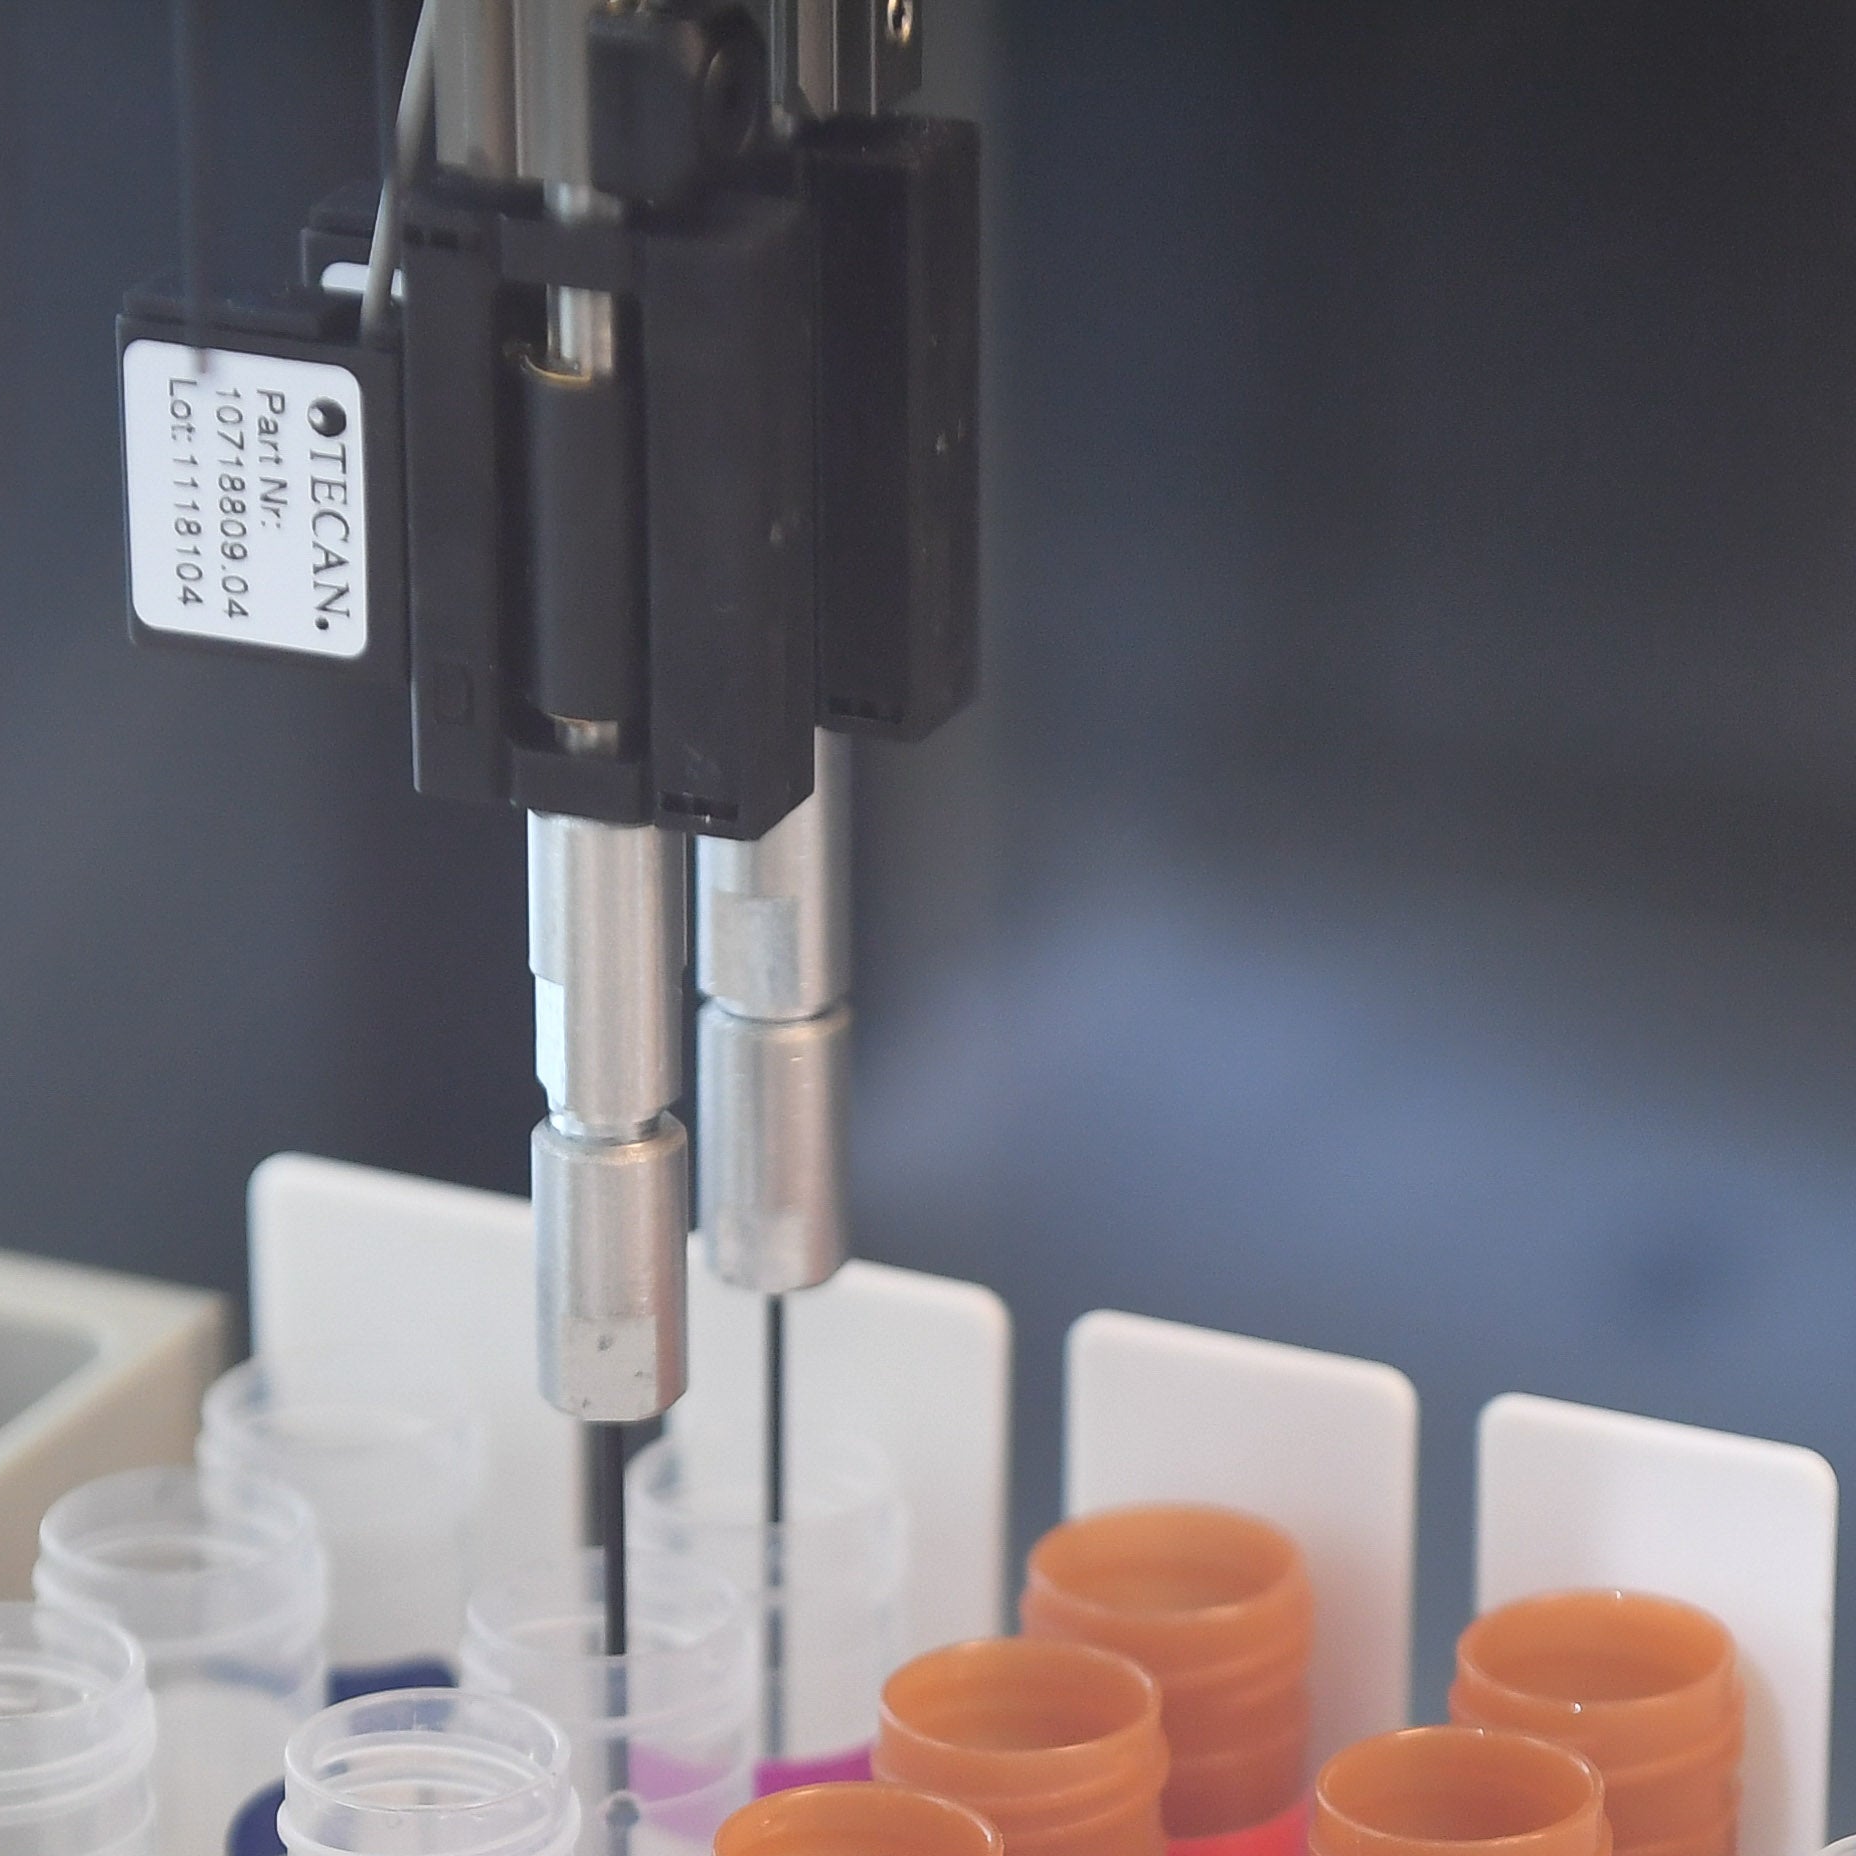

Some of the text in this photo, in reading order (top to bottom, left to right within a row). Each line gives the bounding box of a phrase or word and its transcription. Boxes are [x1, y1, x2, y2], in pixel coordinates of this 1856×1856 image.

[167, 377, 204, 607] Lot: 1118104
[215, 386, 249, 619] 10718809.04
[257, 387, 289, 530] Part Nr:
